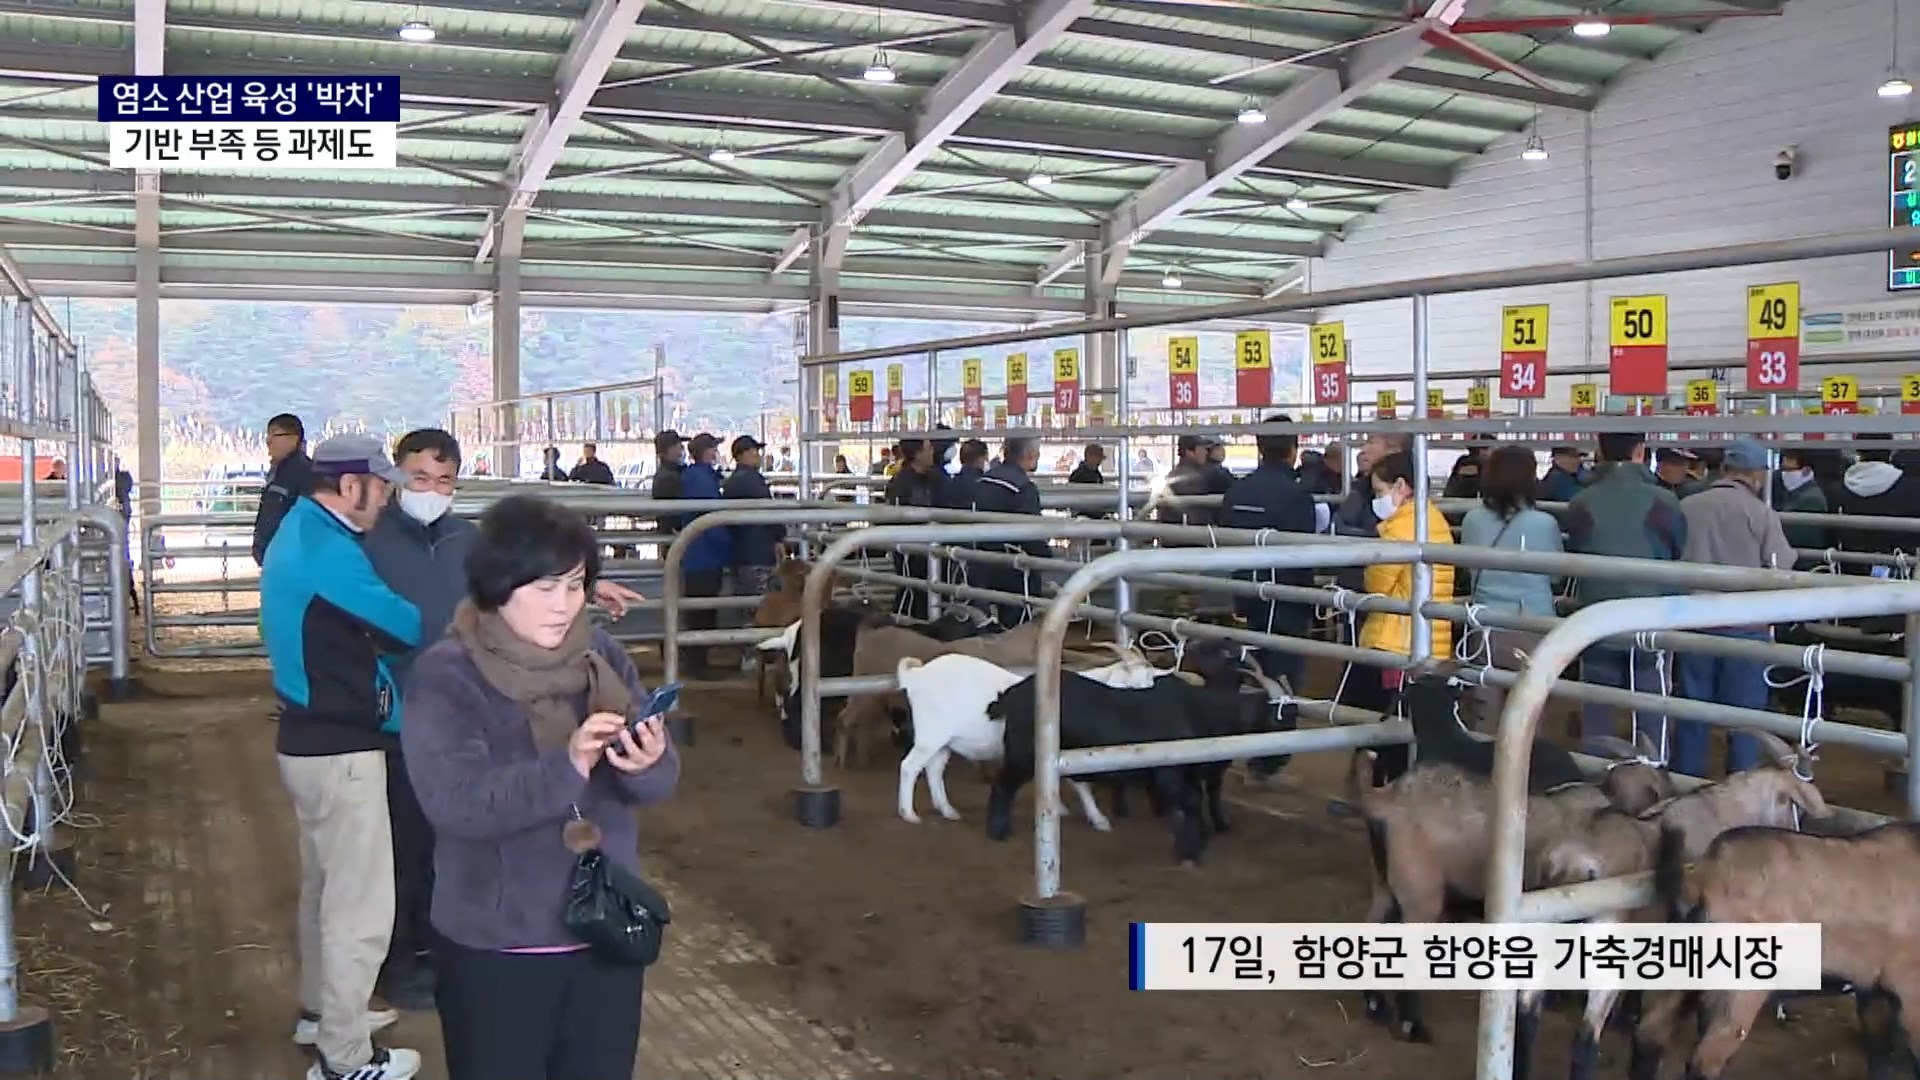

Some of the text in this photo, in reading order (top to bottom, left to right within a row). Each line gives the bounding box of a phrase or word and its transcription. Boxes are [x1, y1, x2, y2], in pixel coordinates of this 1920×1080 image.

[1624, 309, 1653, 338] 50
[1759, 298, 1786, 330] 49
[1513, 318, 1536, 344] 51
[1244, 341, 1262, 363] 53
[1320, 334, 1337, 357] 52
[1060, 357, 1072, 376] 55
[1175, 347, 1190, 368] 54
[1759, 351, 1787, 384] 33
[855, 377, 868, 392] 59
[967, 367, 976, 384] 57
[1322, 373, 1339, 397] 35
[1511, 363, 1535, 391] 34
[1060, 389, 1072, 408] 37
[1176, 382, 1191, 403] 36
[1577, 391, 1590, 404] 34
[1693, 387, 1709, 402] 36
[1831, 383, 1849, 398] 37
